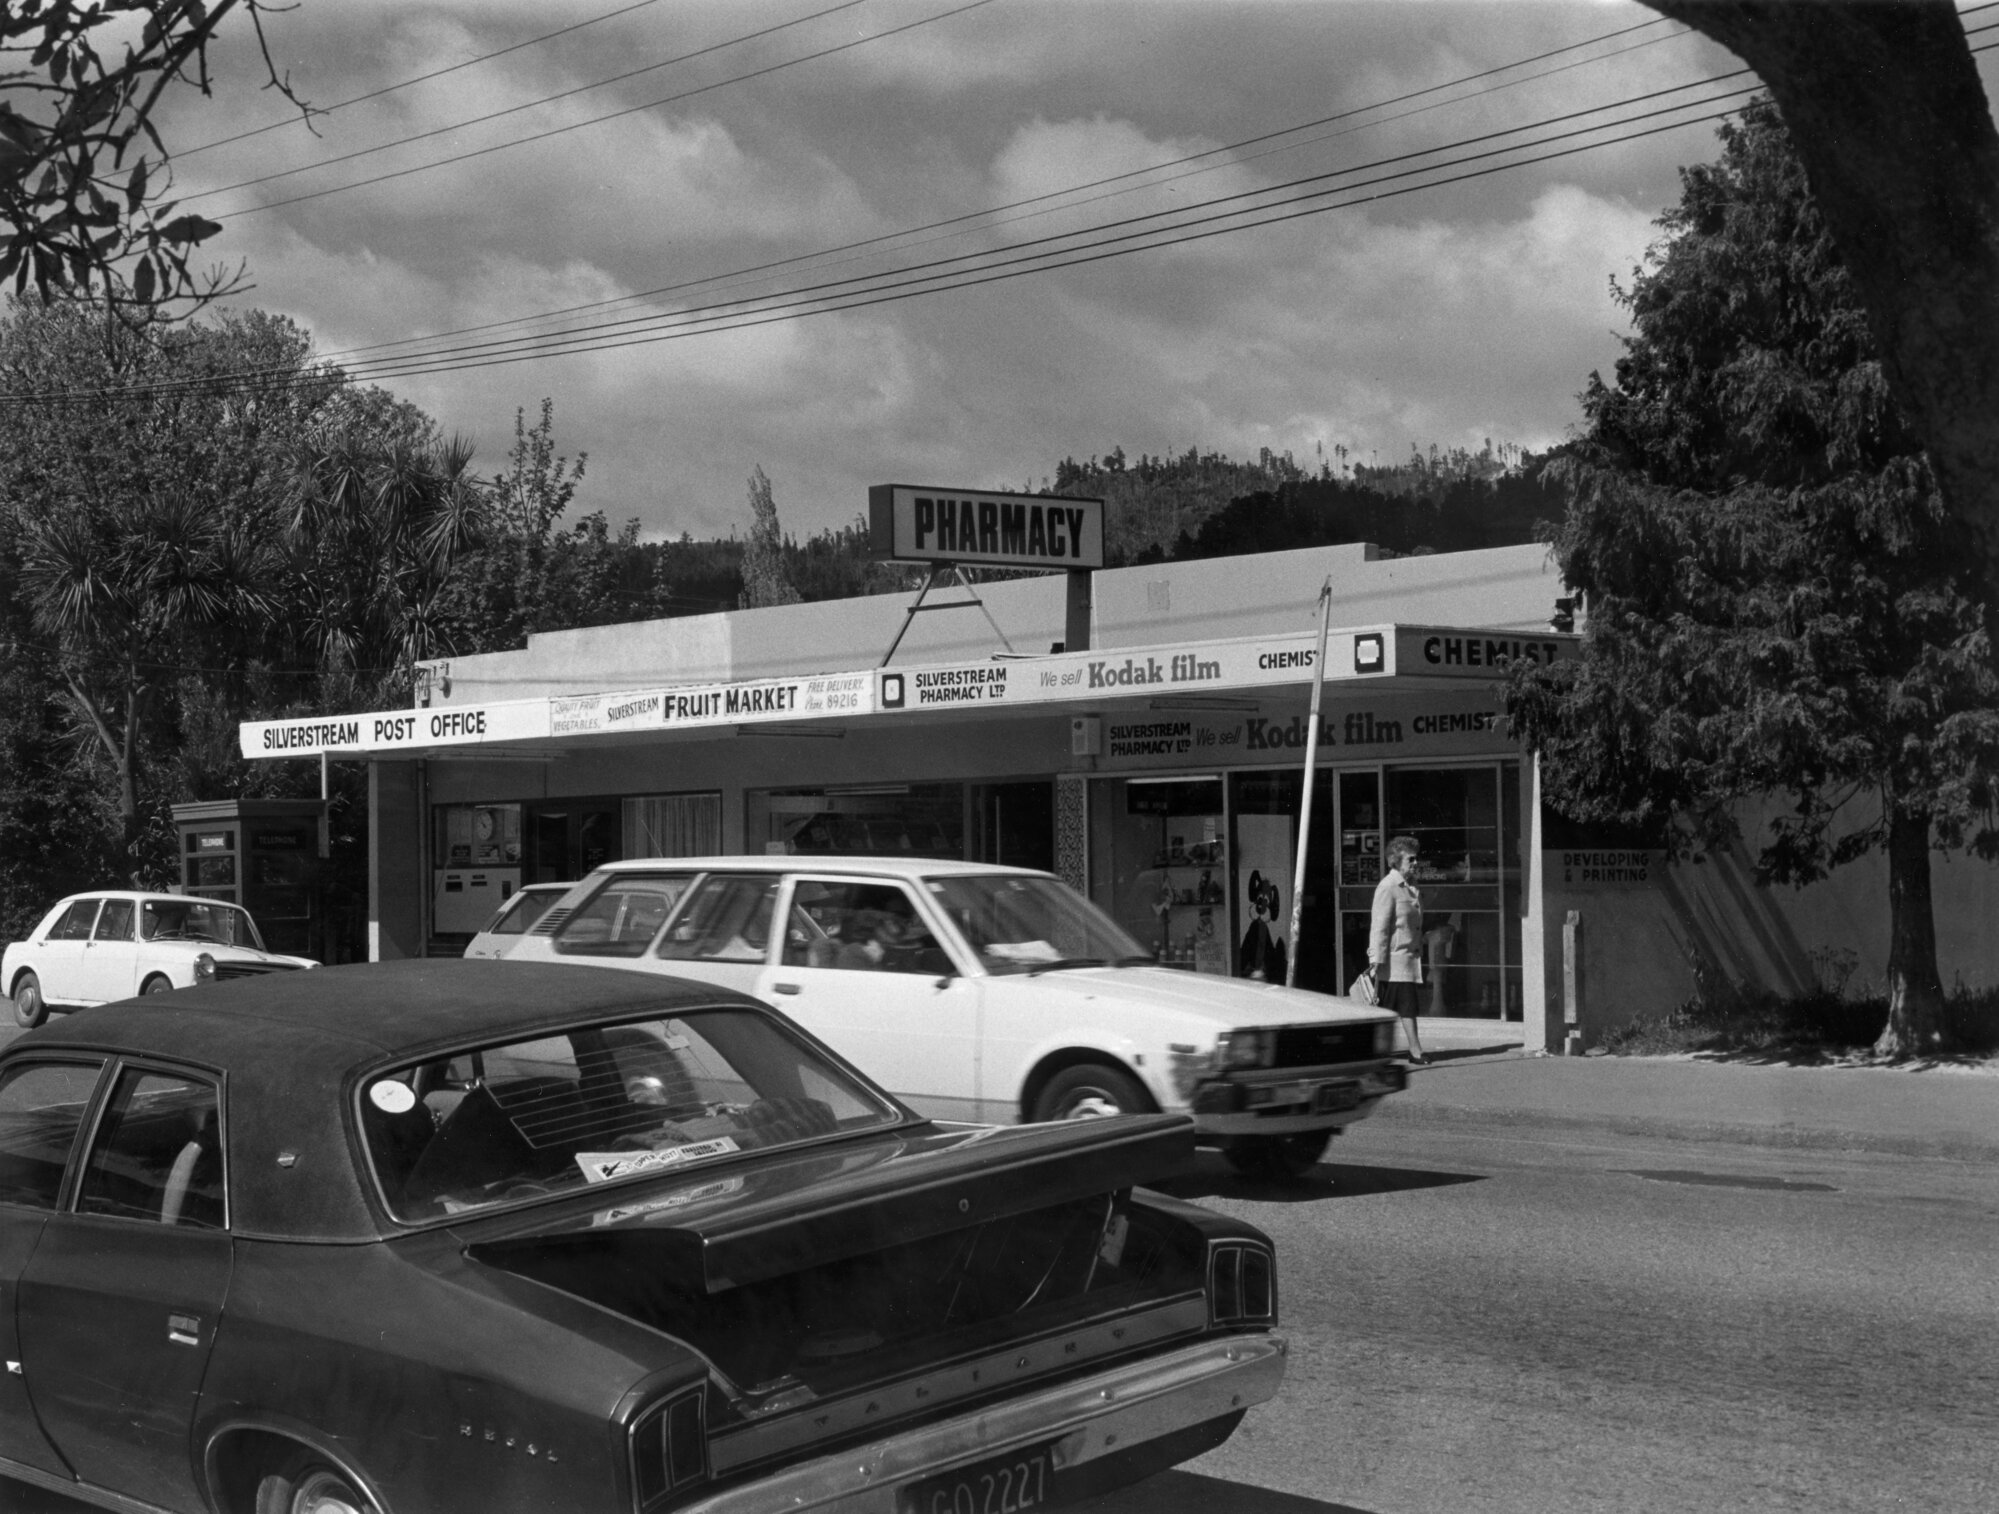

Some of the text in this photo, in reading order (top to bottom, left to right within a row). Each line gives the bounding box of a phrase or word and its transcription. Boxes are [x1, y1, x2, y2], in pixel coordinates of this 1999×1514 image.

[914, 497, 1084, 558] PHARMACY
[1424, 637, 1557, 666] CHEMIST
[915, 667, 1007, 688] SILVERSTREAM
[1040, 654, 1221, 688] We sell Kodak film
[807, 681, 824, 694] FREE
[920, 685, 983, 703] PHARMACY
[608, 697, 658, 722] SILVERSTREAM
[664, 685, 798, 719] FRUIT MARKET
[827, 693, 858, 709] 89216
[264, 711, 485, 749] SILVERSTREAM POST OFFICE
[1110, 722, 1191, 740] SILVERSTREAM
[1196, 727, 1216, 747] We
[1218, 725, 1241, 745] sell
[1344, 712, 1403, 745] film
[1413, 711, 1496, 734] CHEMIST
[1111, 739, 1173, 757] PHARMACY
[1564, 852, 1649, 867] DEVELOPING
[1582, 869, 1647, 882] PRINTING
